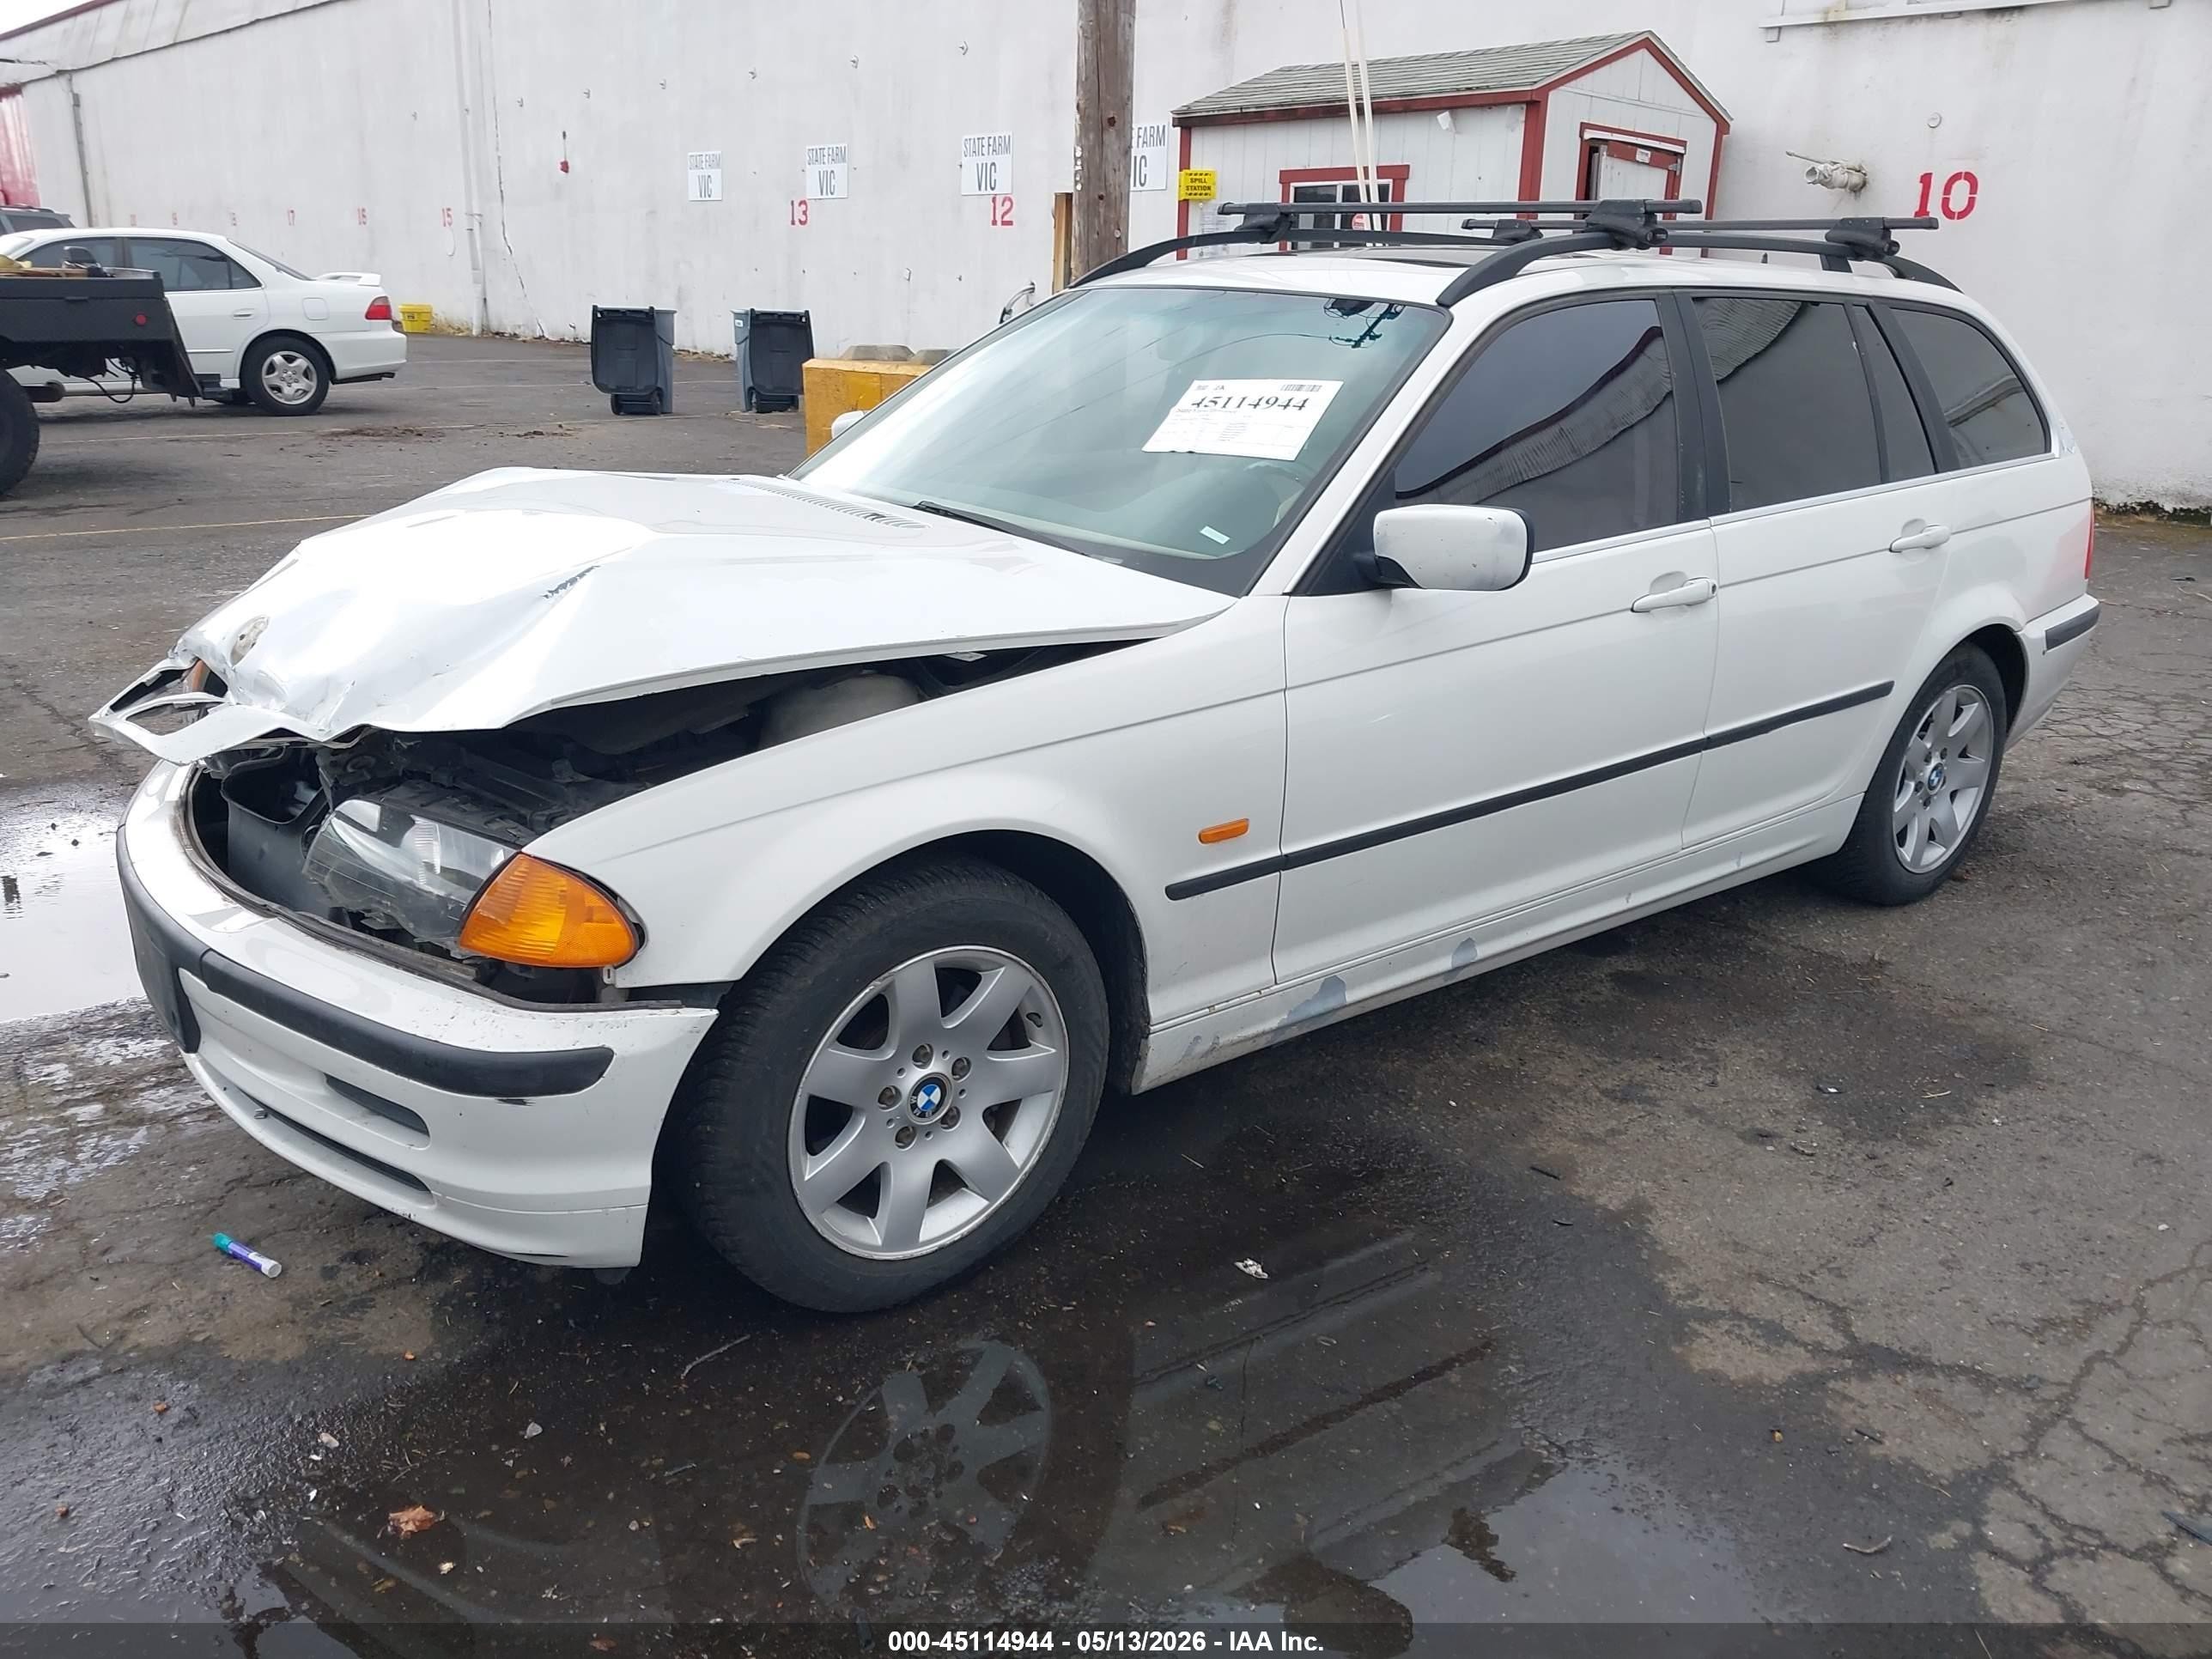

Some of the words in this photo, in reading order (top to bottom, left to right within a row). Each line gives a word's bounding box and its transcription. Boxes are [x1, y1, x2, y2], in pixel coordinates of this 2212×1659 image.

[963, 137, 986, 157] STATE
[988, 135, 1011, 155] FARM
[1137, 125, 1166, 149] FARM
[807, 148, 825, 166] STATE
[827, 145, 847, 164] FARM
[818, 170, 836, 196] VIC
[976, 161, 997, 191] VIC
[1133, 155, 1147, 187] IC
[697, 174, 713, 198] VIC
[1914, 171, 1978, 221] 10
[441, 207, 453, 228] 15
[790, 199, 808, 226] 13
[991, 196, 1013, 226] 12
[1190, 395, 1310, 411] 45114944
